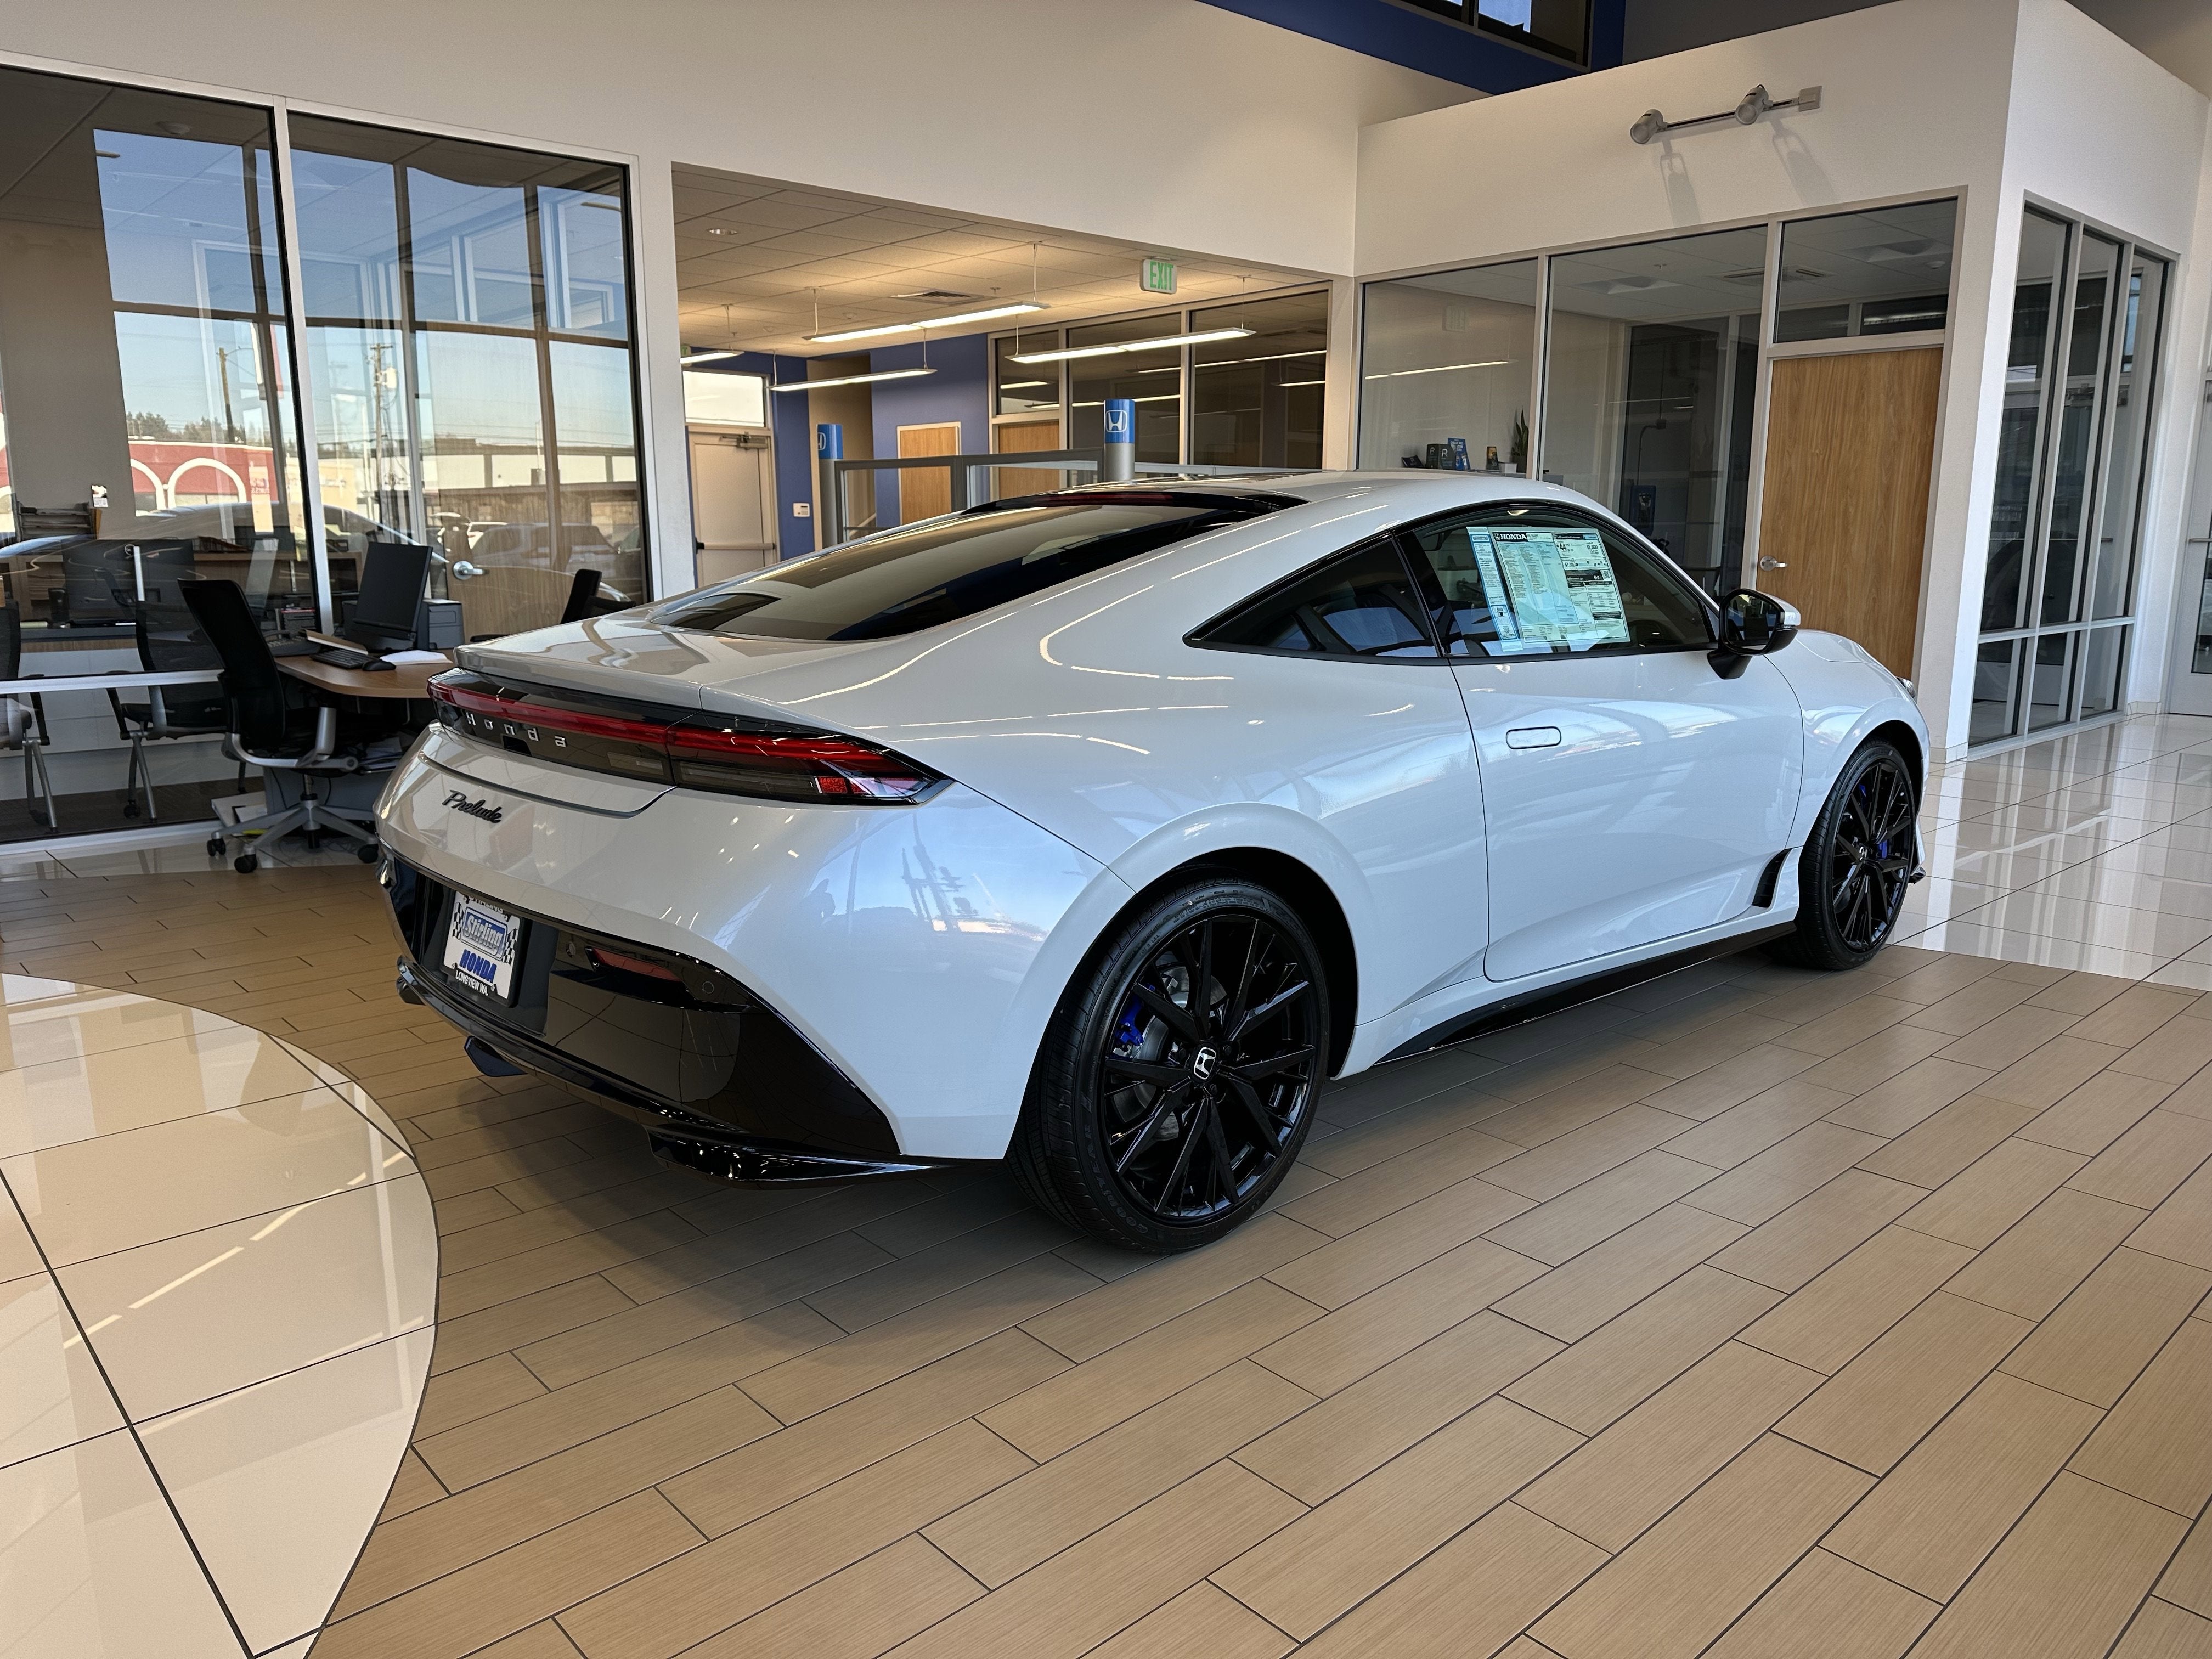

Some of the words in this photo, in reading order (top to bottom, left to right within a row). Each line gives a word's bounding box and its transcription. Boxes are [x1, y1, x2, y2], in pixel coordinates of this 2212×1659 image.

[1149, 261, 1174, 291] EXIT
[441, 789, 503, 823] Prelude
[464, 915, 503, 951] Stirling
[455, 969, 480, 991] LONGVIEW
[479, 983, 488, 996] WA.
[460, 949, 496, 983] HONDA
